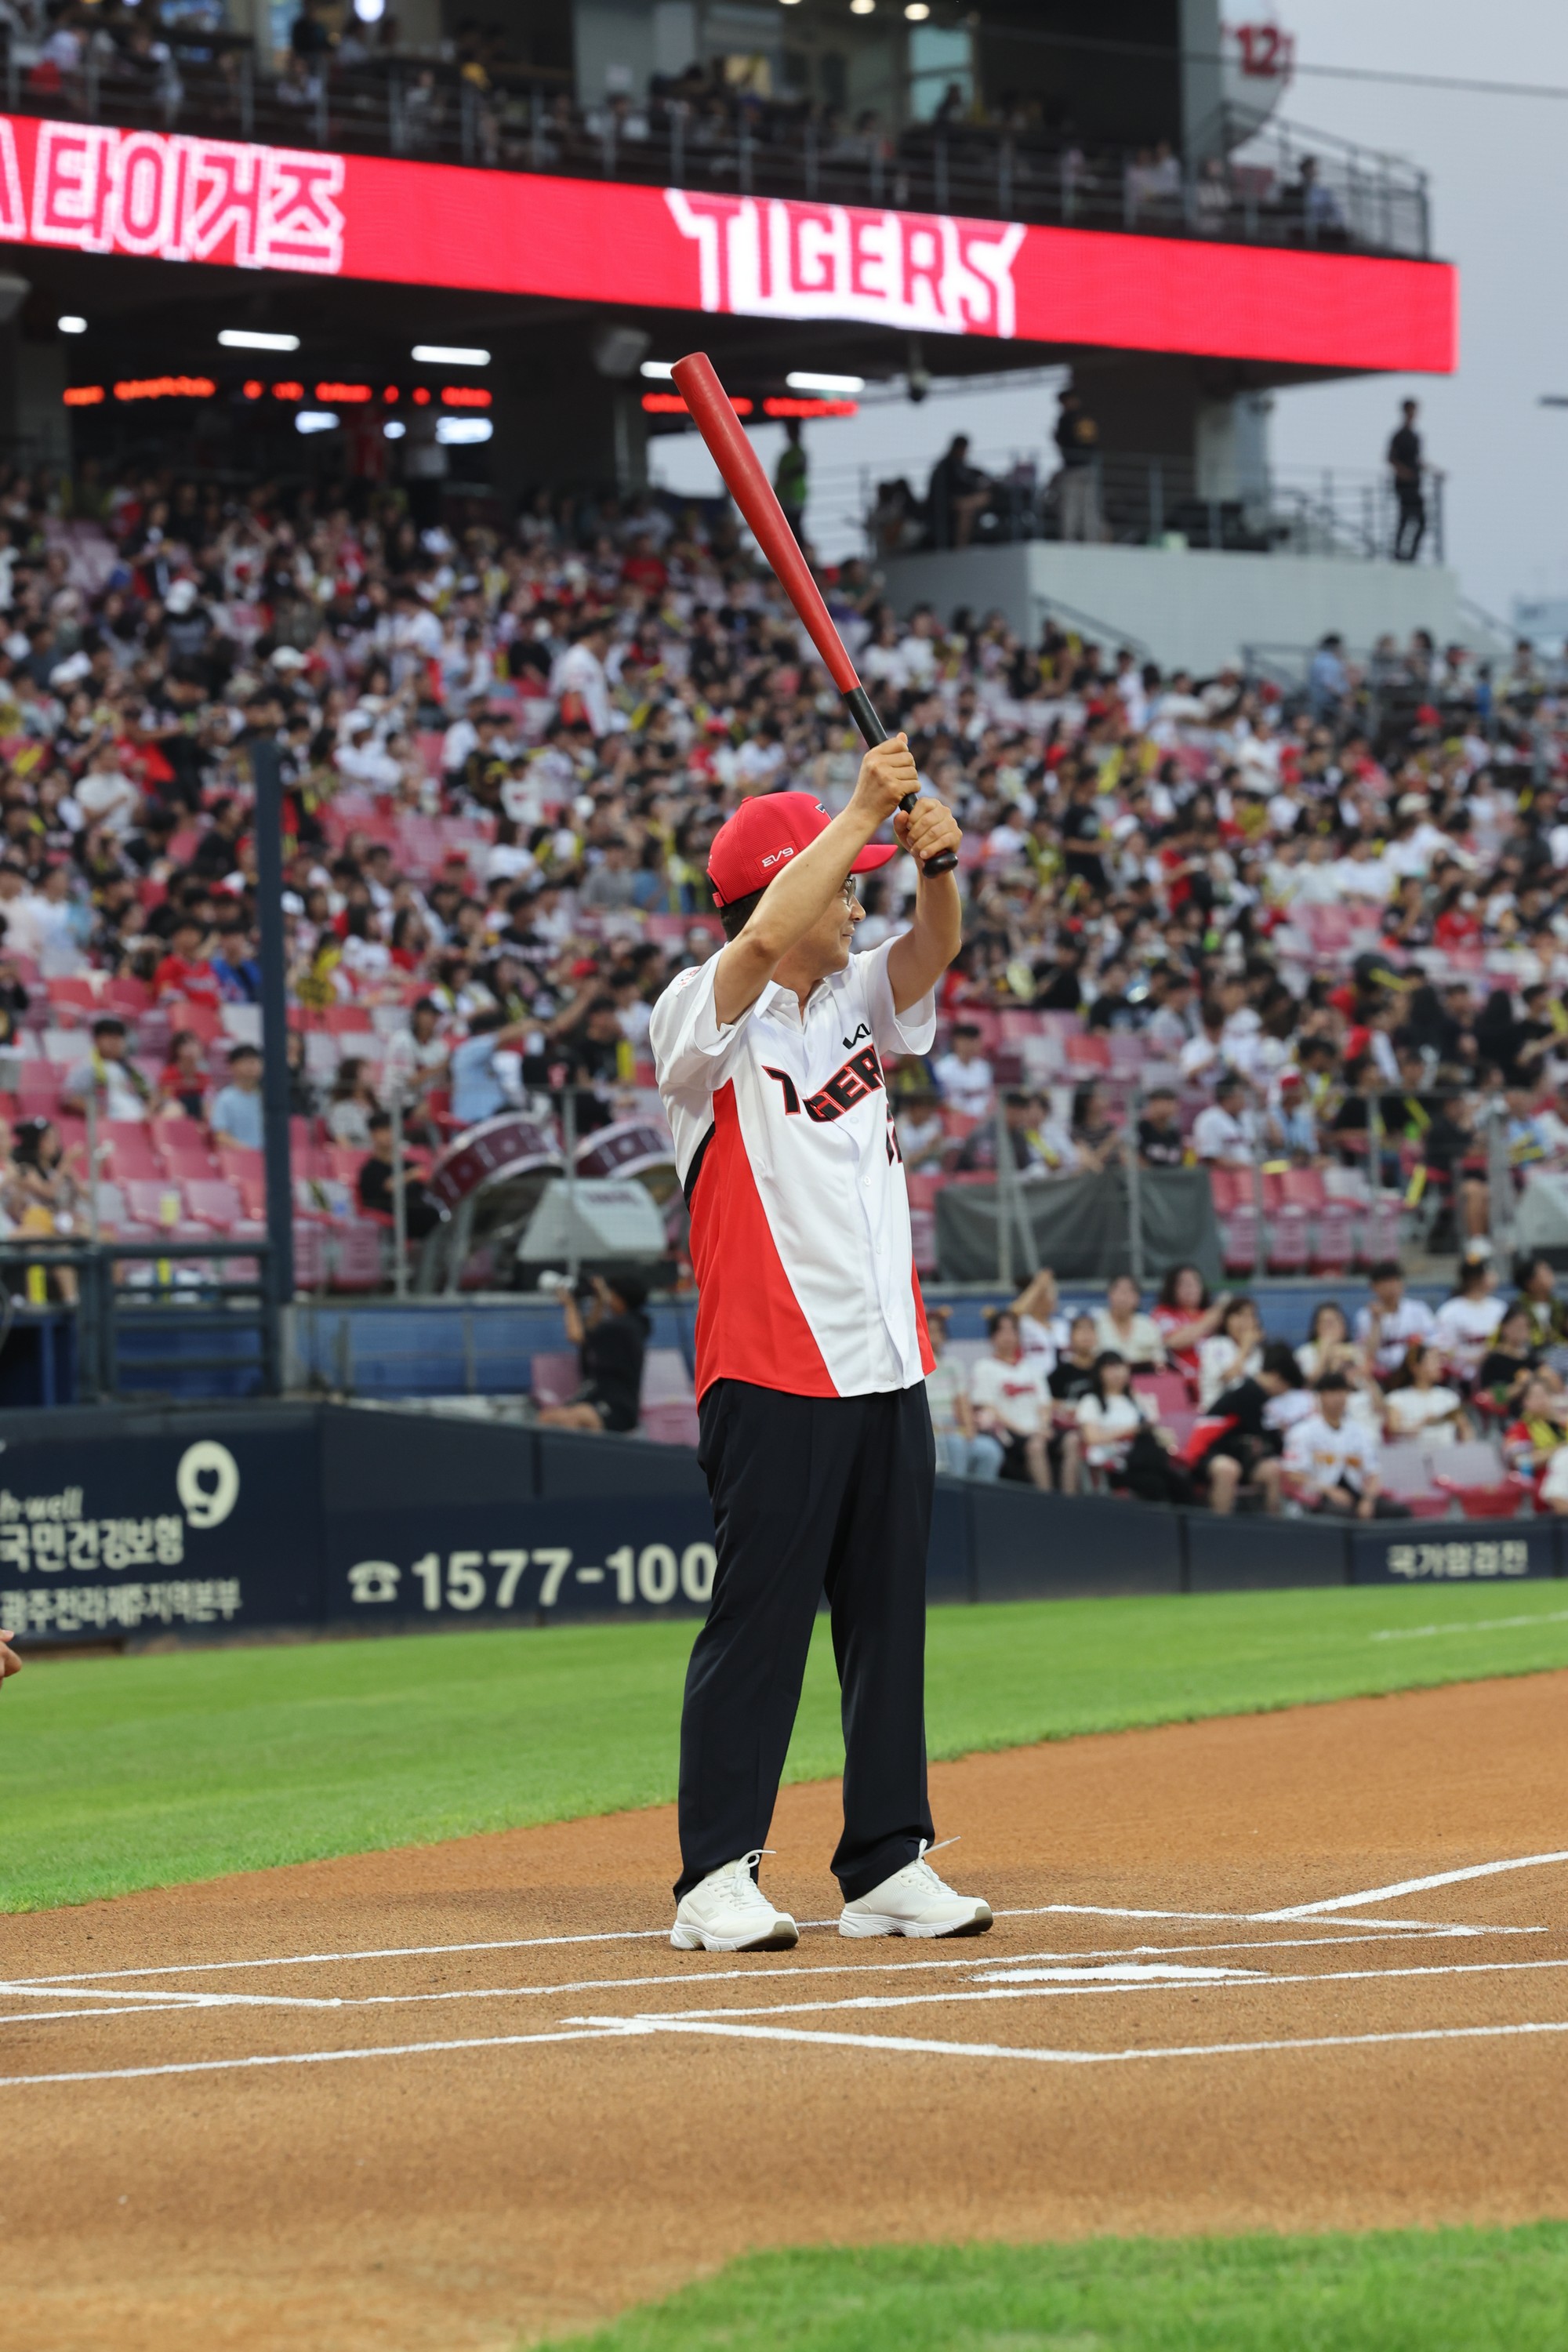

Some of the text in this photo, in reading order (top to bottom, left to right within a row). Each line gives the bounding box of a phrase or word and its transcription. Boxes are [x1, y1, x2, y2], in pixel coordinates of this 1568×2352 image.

[31, 119, 346, 274] 타이거즈
[664, 188, 1027, 339] TIGERS
[761, 847, 794, 868] EV9
[0, 1514, 184, 1573] 국민건강보험
